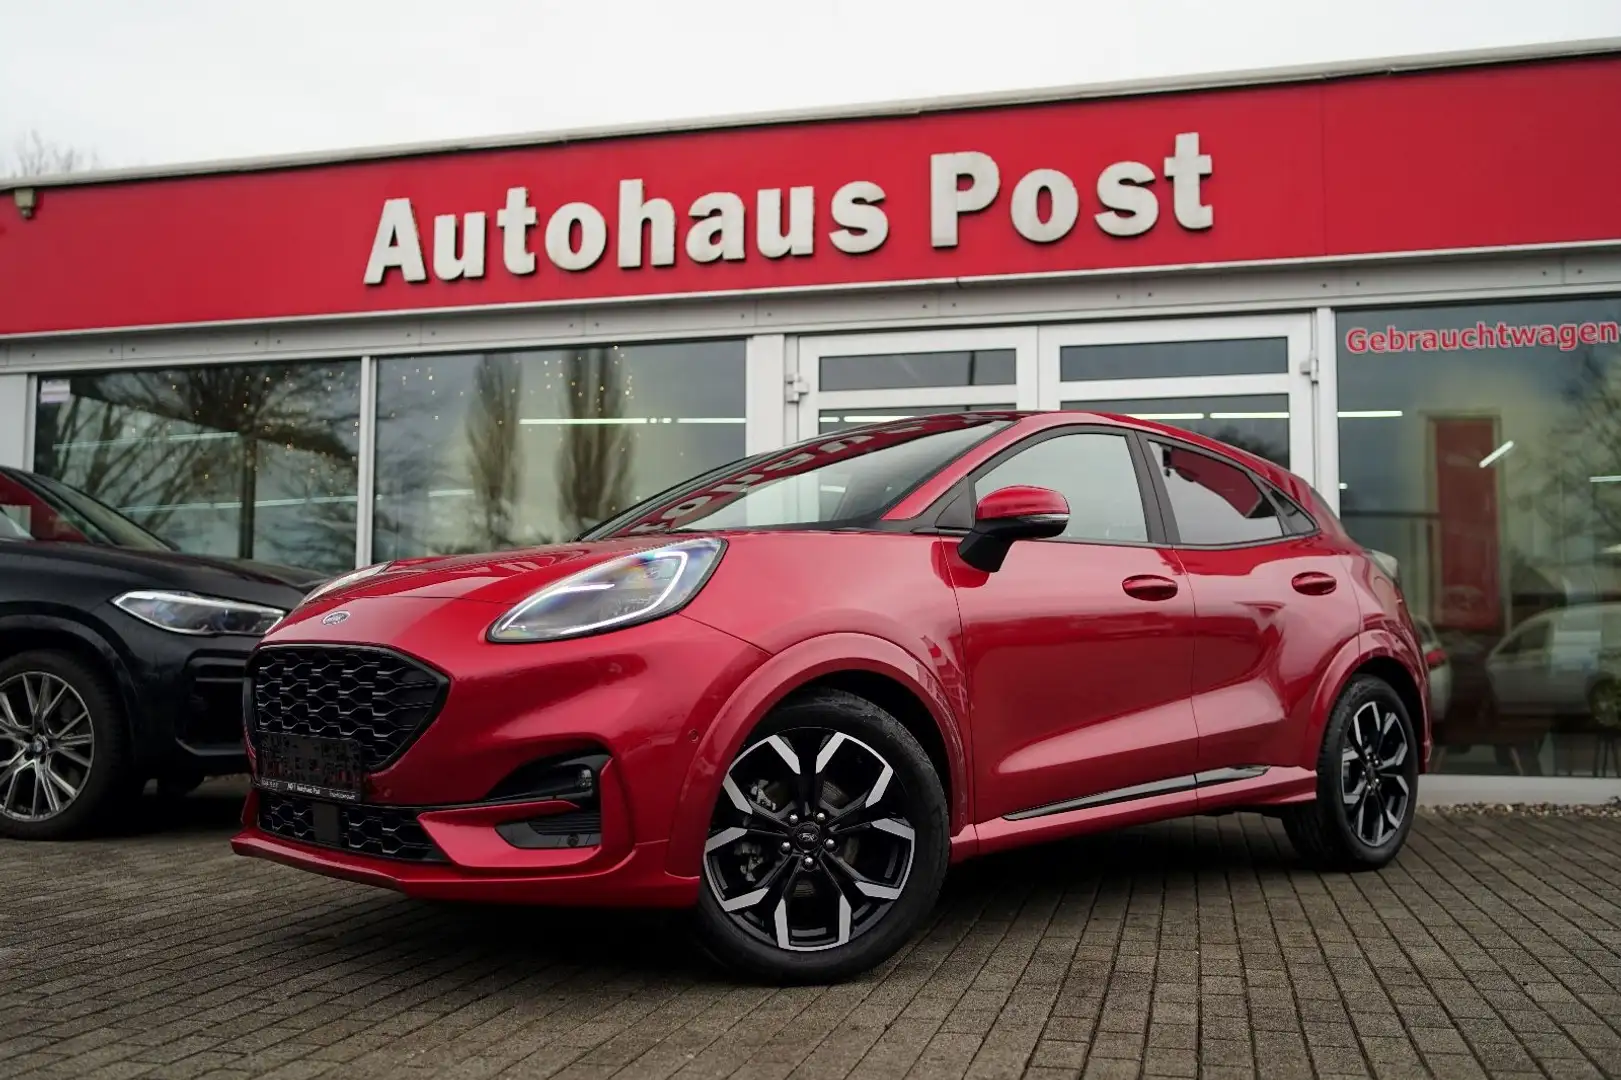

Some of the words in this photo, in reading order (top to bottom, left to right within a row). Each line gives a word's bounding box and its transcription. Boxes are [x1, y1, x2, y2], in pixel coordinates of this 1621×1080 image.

[363, 178, 889, 284] Autohaus
[930, 132, 1214, 247] Post
[1346, 320, 1619, 354] Gebrauchtwagen
